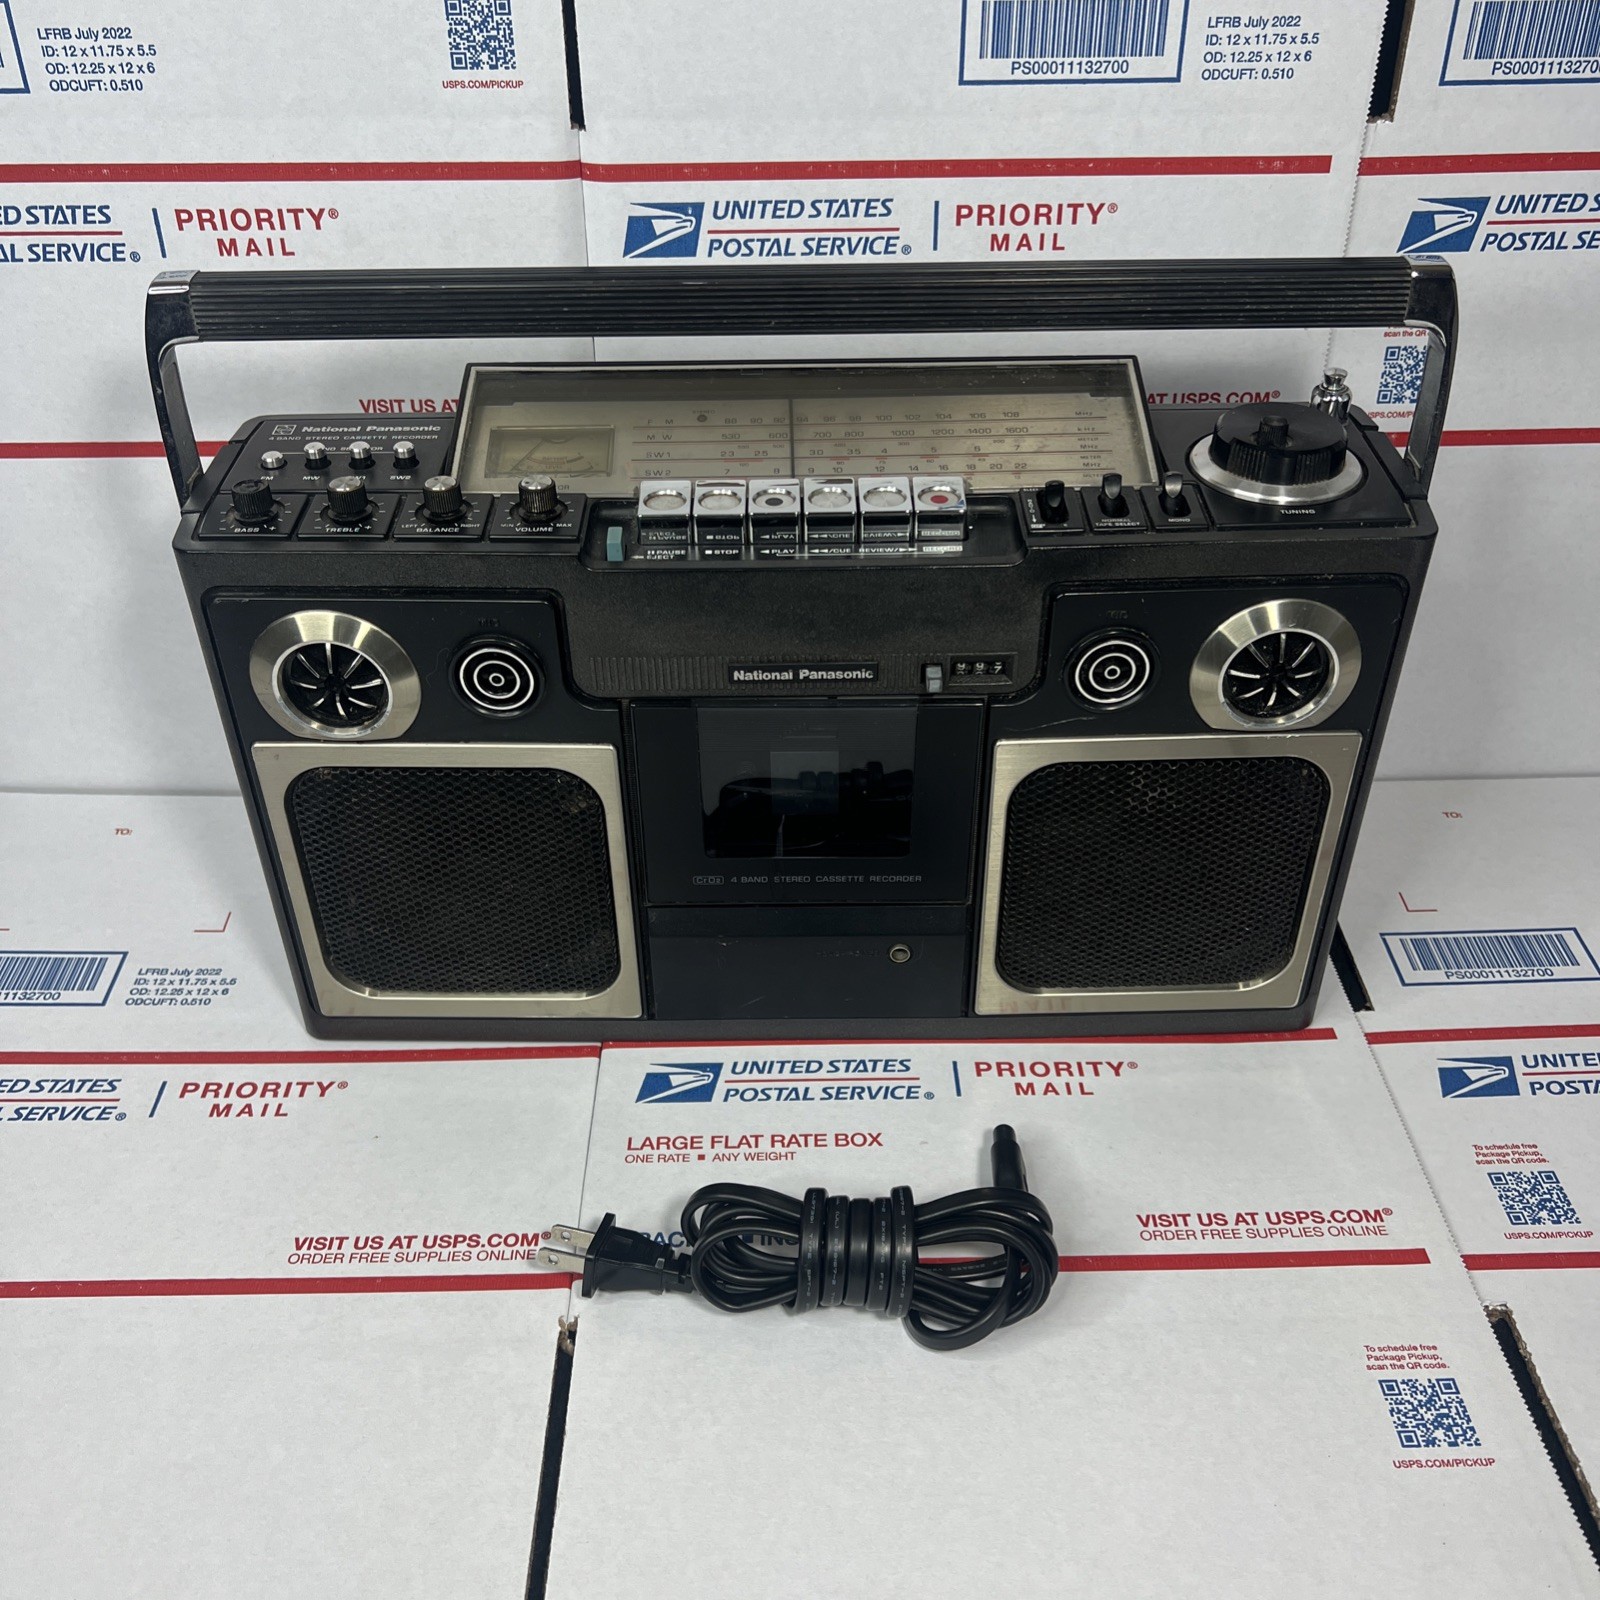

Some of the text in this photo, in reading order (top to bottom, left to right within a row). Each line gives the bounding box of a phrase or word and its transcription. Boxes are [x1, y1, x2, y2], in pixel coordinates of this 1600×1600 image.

[1208, 16, 1301, 30] LFRB July 2022
[37, 27, 132, 42] LFRB July 2022
[1206, 33, 1319, 46] ID: 12 11.75 5.5
[41, 45, 156, 57] ID: 12 11.75 5.5
[1204, 51, 1312, 63] OD: 12.25 12 6
[45, 62, 155, 74] OD: 12.25 12 6
[1011, 60, 1129, 75] PS00011132700
[1202, 68, 1294, 80] ODCUFT: 0.510
[50, 80, 143, 91] ODCUFT: 0.510
[442, 80, 523, 88] USPS.COM/PICKUP
[713, 199, 893, 220] UNITED STATES
[1496, 193, 1588, 214] UNITED
[25, 205, 111, 224] STATES
[217, 238, 295, 256] MAIL
[708, 238, 796, 257] POSTAL
[991, 233, 1065, 251] MAIL
[1480, 232, 1568, 251] POSTAL
[359, 399, 437, 413] VISIT US
[302, 425, 361, 433] National
[734, 669, 873, 680] National Panasonic
[138, 968, 222, 977] LFRB July 2022
[1445, 968, 1554, 980] PS00011132700
[129, 988, 229, 996] OD: 12.25 12 6
[125, 998, 211, 1006] ODCUFT: 0.510
[731, 1059, 911, 1074] UNITED STATES
[1522, 1053, 1600, 1068] UNITE
[29, 1079, 121, 1093] STATES
[1015, 1082, 1094, 1095] MAIL
[723, 1087, 814, 1102] POSTAL
[209, 1103, 288, 1117] MAIL
[627, 1133, 883, 1150] LARGE FLAT RATE BOX
[625, 1152, 796, 1163] ONE RATE ANY WEIGHT
[1136, 1214, 1191, 1227] VISIT
[1197, 1213, 1228, 1226] US
[1235, 1211, 1259, 1225] AT
[1140, 1226, 1388, 1241] ORDER FREE SUPPLIES ONLINE
[1504, 1231, 1593, 1239] USPS.COM/PICKUP
[295, 1237, 349, 1250] VISIT
[354, 1236, 384, 1250] US
[388, 1236, 418, 1249] AT
[288, 1250, 536, 1264] ORDER FREE SUPPLIES ONLINE
[1366, 1353, 1442, 1362] Package Pickup,
[1406, 1362, 1422, 1370] QR
[1393, 1458, 1495, 1468] USPS.COM/PICKUP
